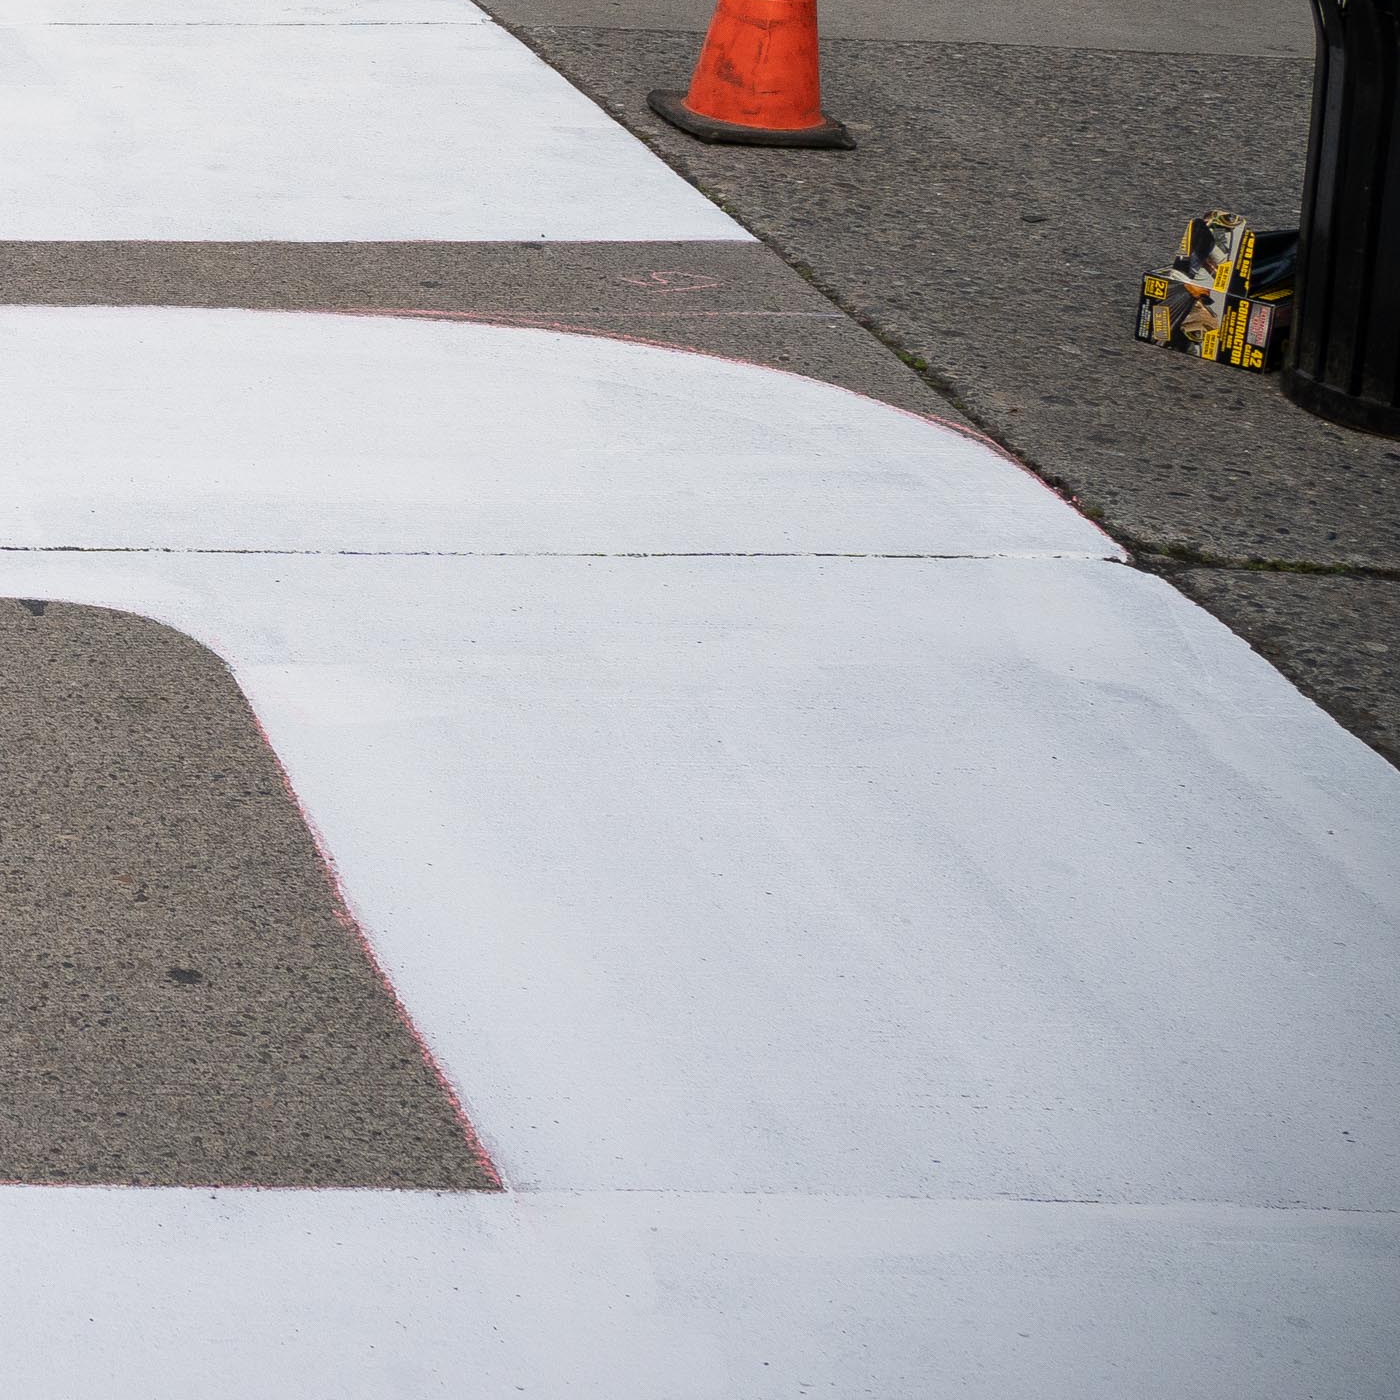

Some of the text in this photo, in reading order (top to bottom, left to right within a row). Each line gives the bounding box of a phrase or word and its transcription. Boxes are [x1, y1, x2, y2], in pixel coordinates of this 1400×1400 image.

[1155, 280, 1165, 297] 24
[1230, 299, 1250, 365] CONTRACTOR
[1242, 343, 1252, 368] GALLON
[1249, 348, 1264, 369] 42
